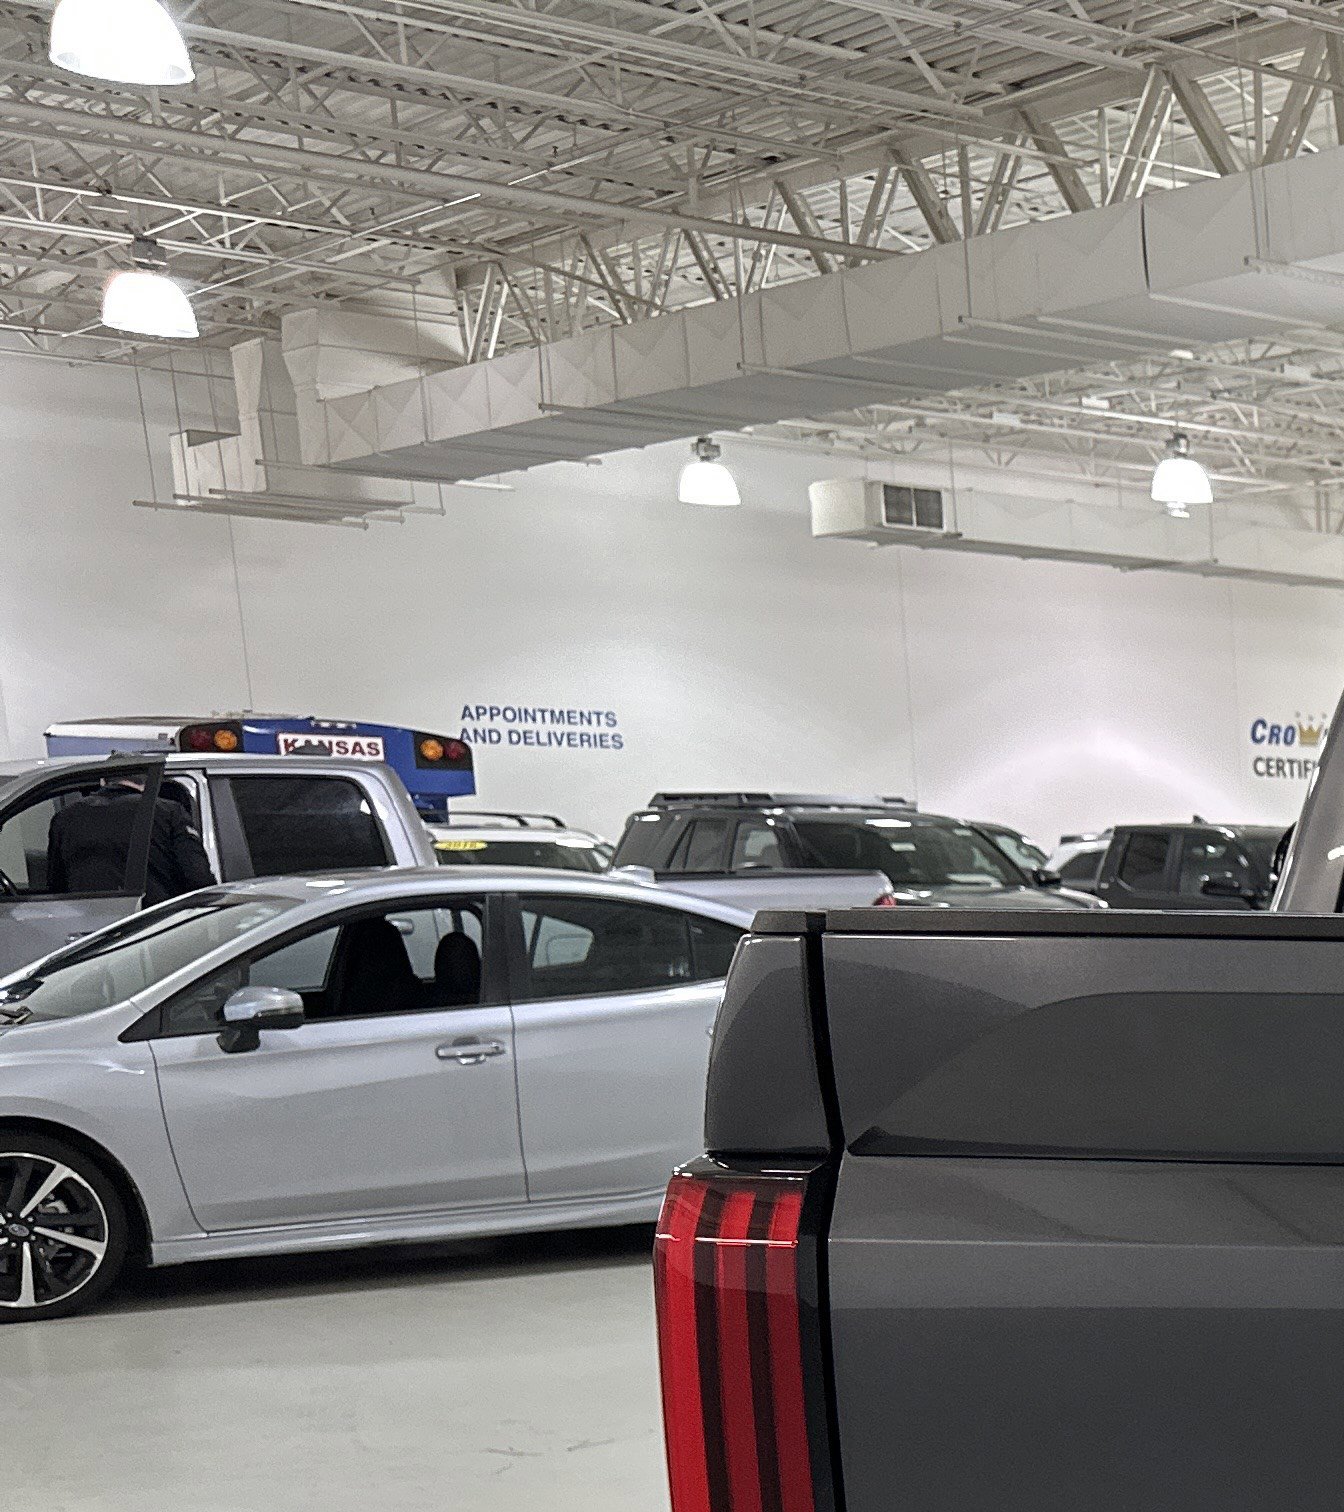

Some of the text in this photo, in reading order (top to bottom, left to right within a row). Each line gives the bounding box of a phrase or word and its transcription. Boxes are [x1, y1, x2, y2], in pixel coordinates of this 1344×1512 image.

[461, 704, 618, 728] APPOINTMENTS
[460, 727, 624, 750] AND DELIVERIES
